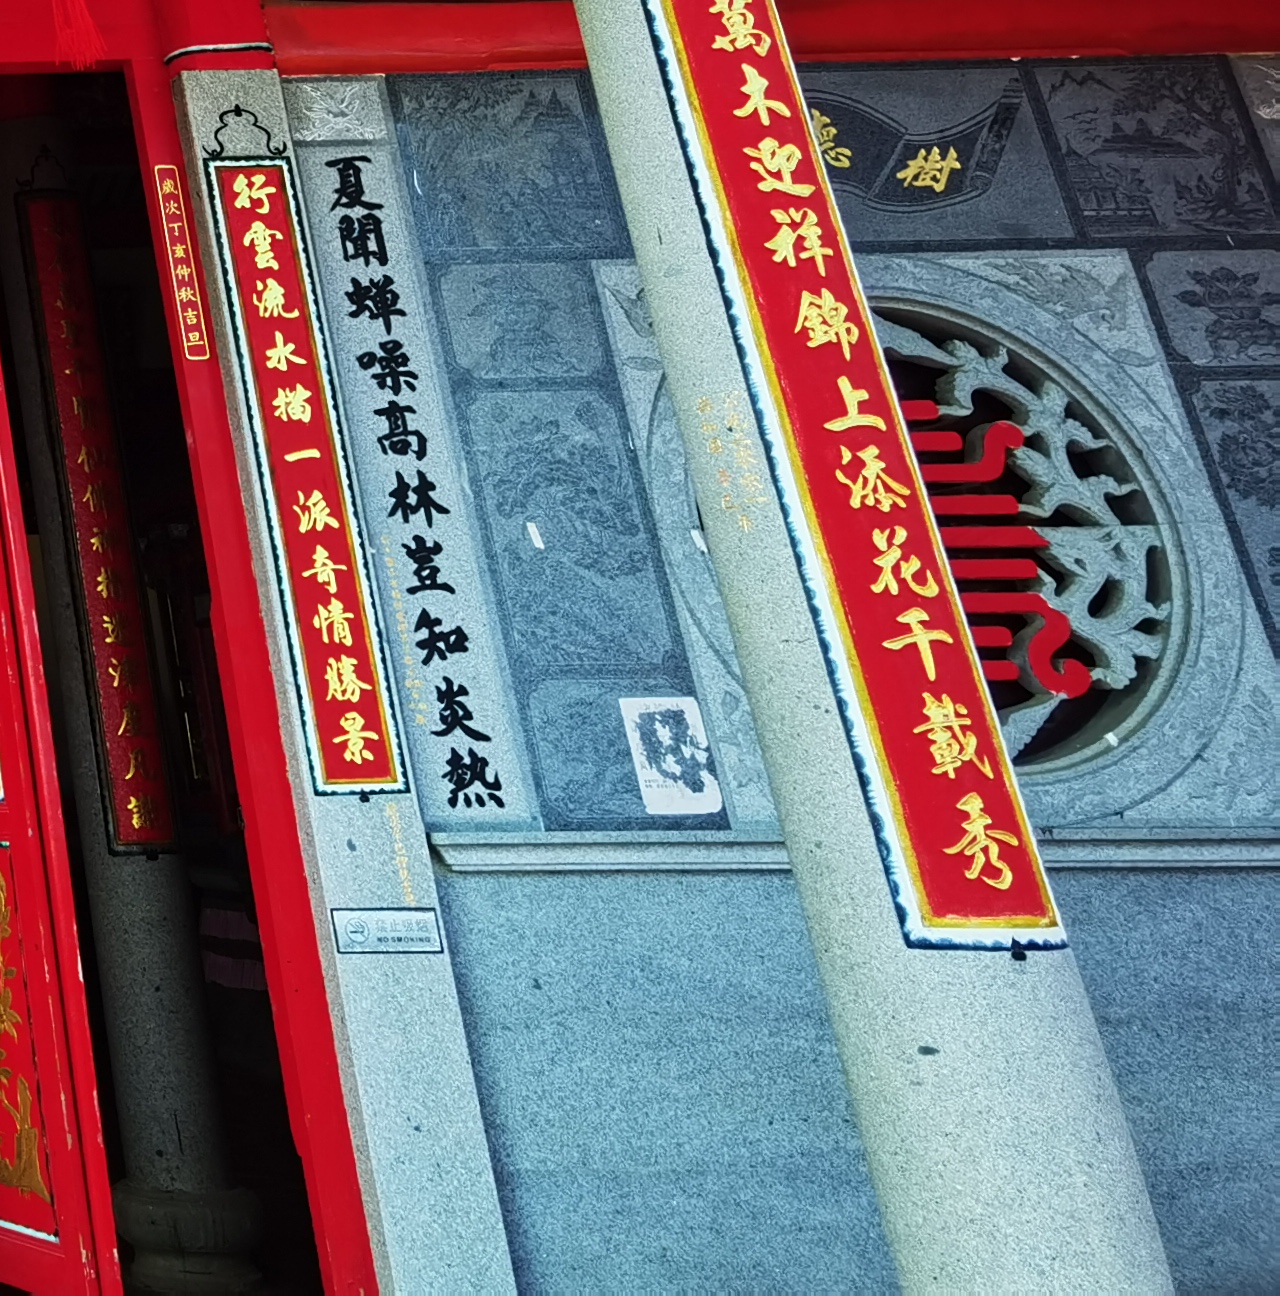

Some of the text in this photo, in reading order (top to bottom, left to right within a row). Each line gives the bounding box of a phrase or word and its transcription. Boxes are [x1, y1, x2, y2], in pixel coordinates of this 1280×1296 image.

[161, 178, 204, 345] 歲次丁亥仲秋吉旦
[391, 936, 431, 944] SMOKING
